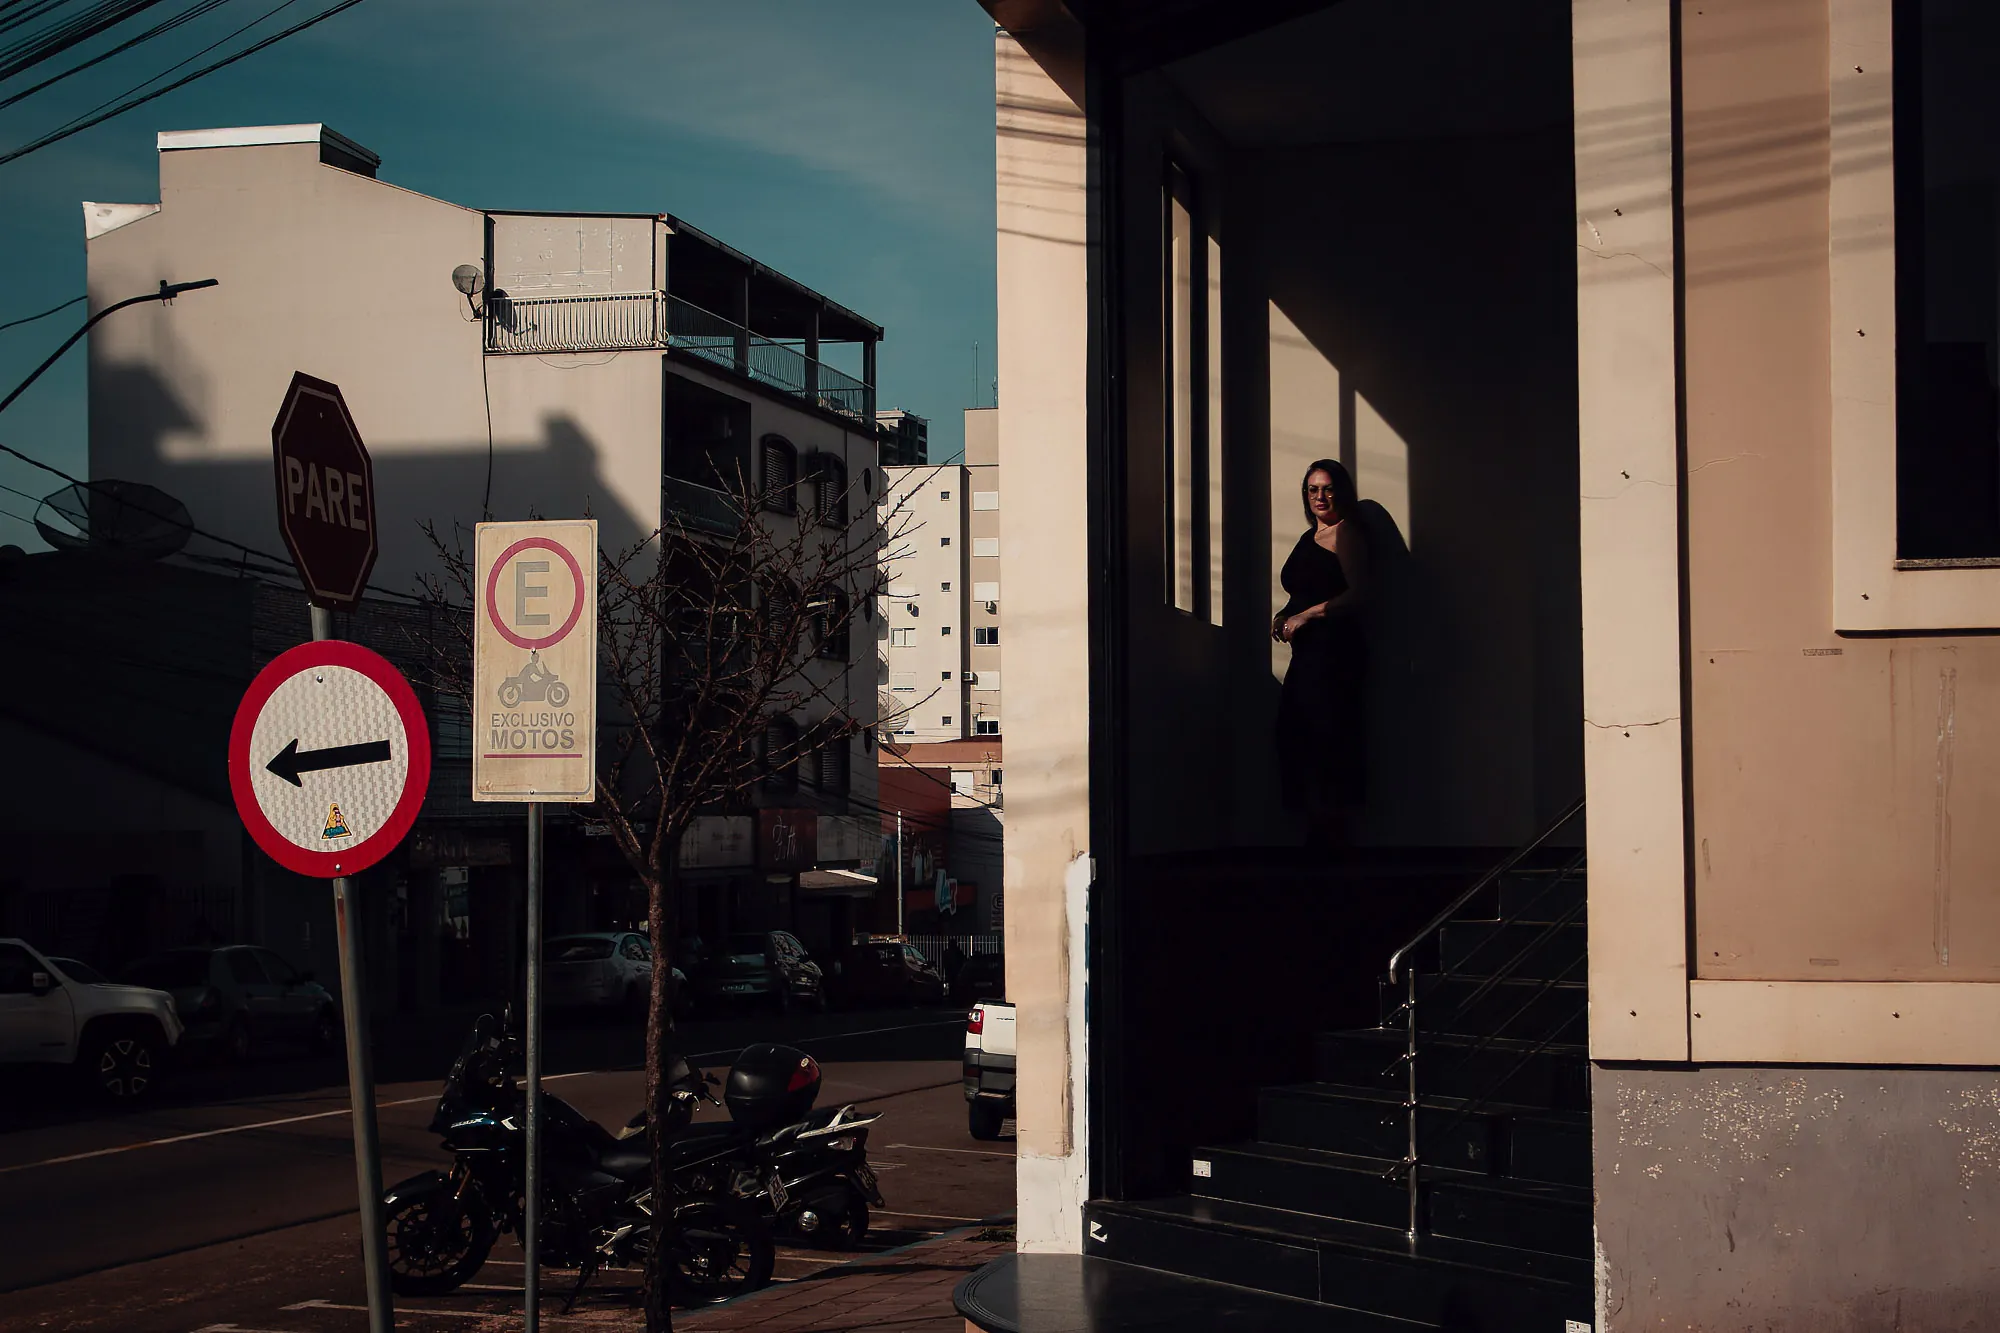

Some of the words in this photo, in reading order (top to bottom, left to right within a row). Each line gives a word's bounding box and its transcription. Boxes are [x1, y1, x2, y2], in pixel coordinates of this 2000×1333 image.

[285, 456, 367, 532] PARE
[515, 561, 550, 626] E
[491, 712, 575, 728] EXCLUSIVO
[491, 729, 575, 750] MOTOS
